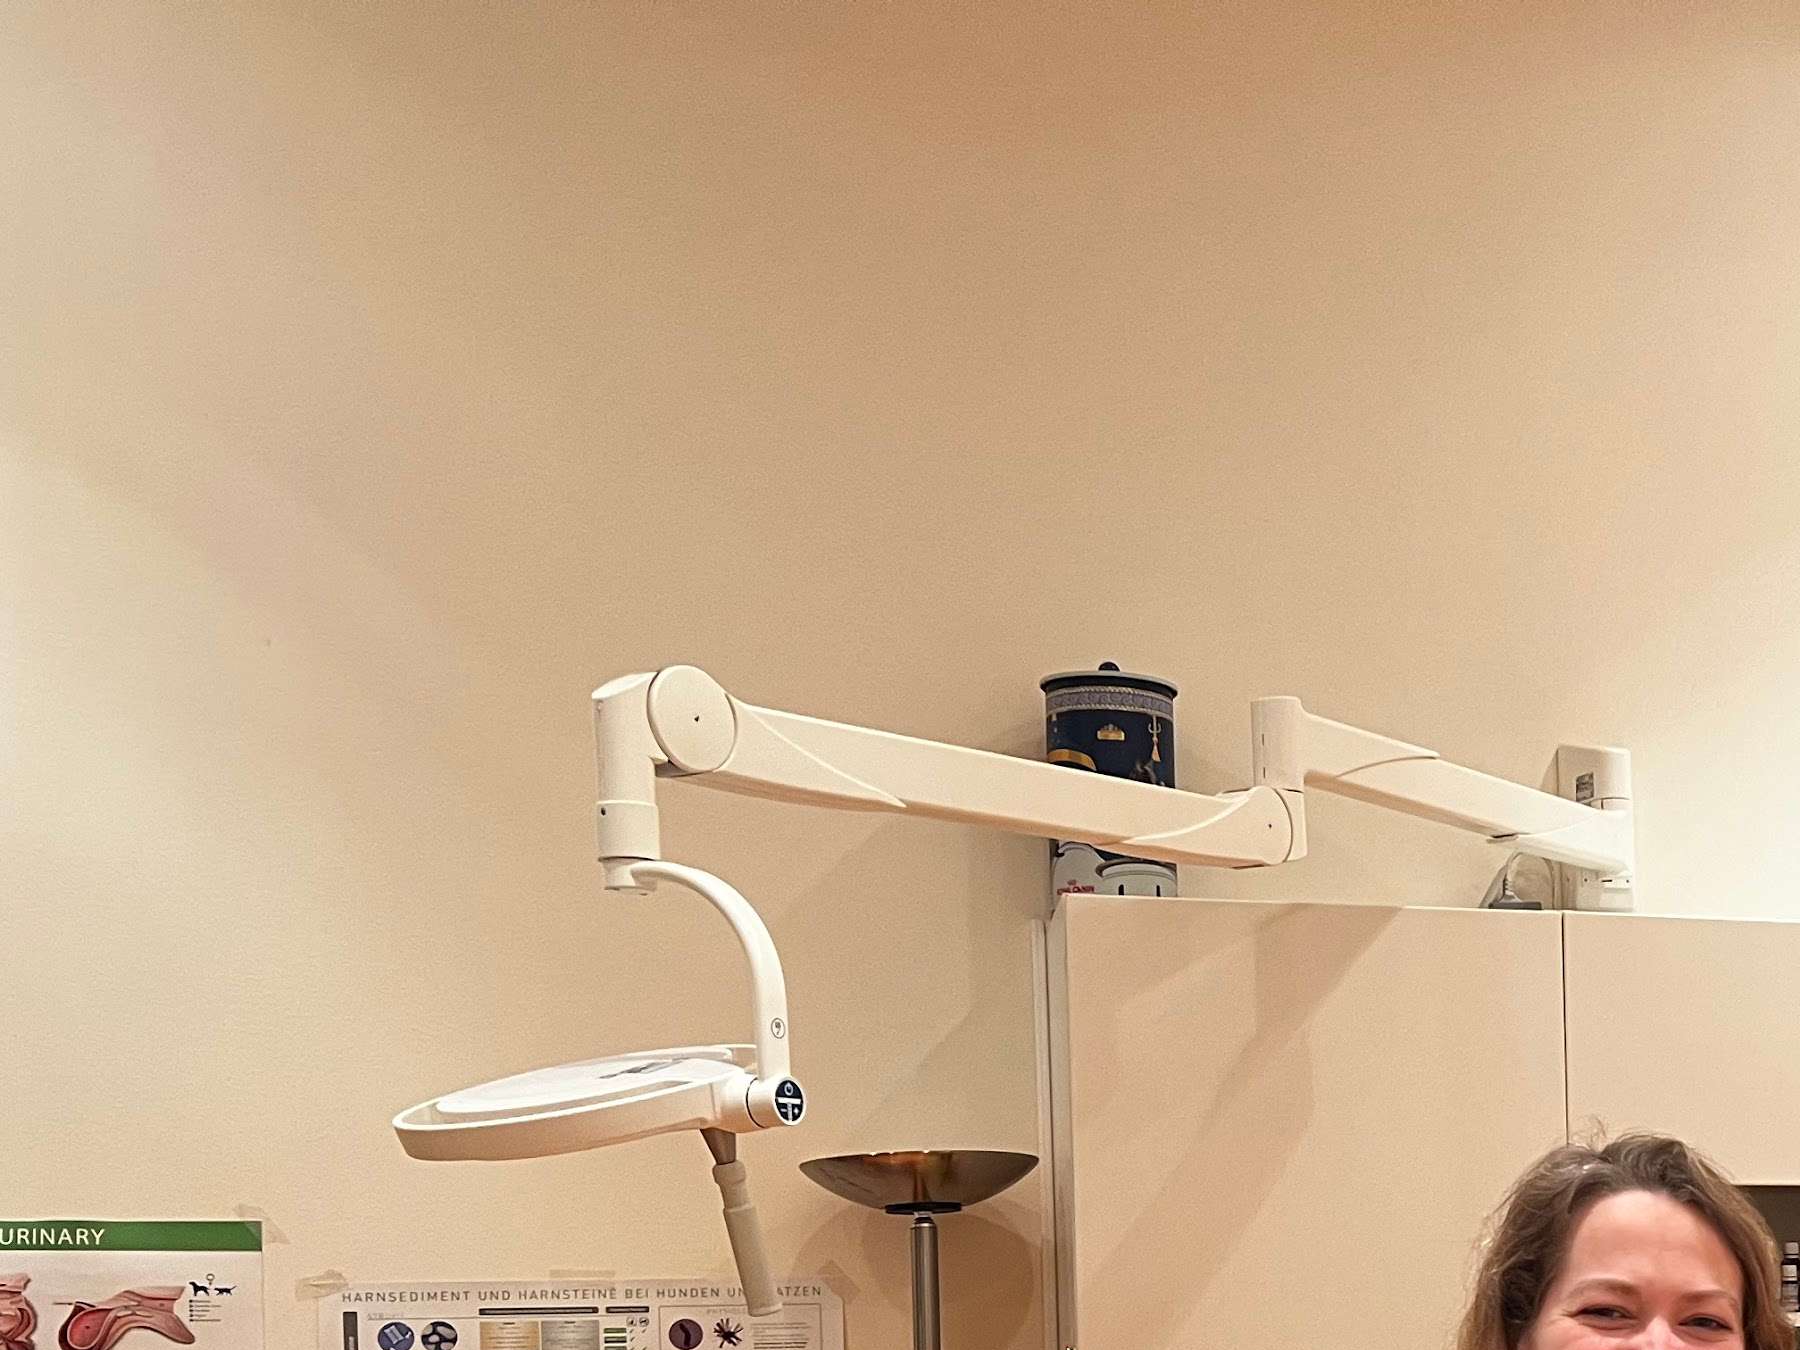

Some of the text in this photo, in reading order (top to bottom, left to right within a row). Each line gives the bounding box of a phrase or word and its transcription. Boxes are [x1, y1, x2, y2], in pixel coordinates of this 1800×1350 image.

[0, 1227, 105, 1246] URINARY
[342, 1286, 822, 1303] HARNSEDIMENT UND HARNSTEINE BEI HUNDEN UN ATZEN
